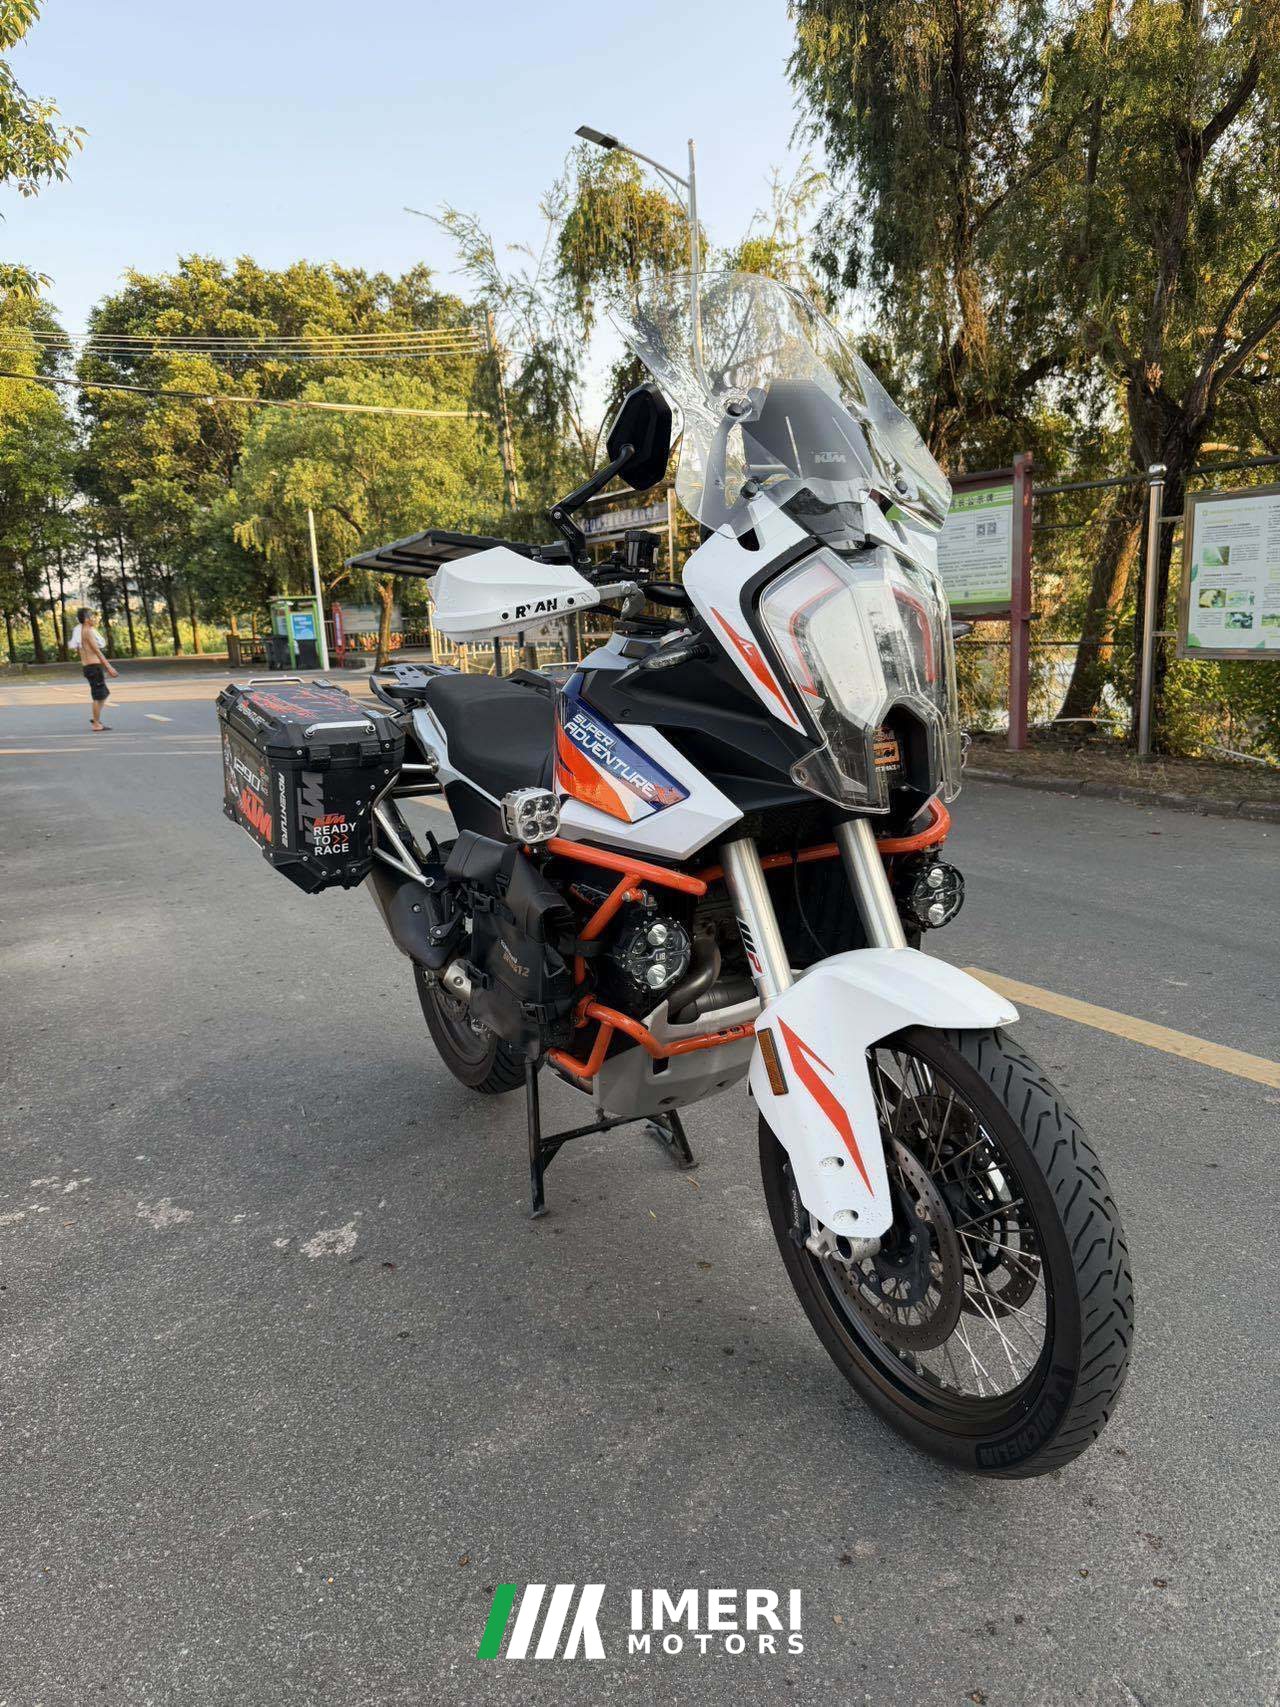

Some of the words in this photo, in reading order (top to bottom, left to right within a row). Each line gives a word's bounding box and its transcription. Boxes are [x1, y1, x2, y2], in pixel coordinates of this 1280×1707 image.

[814, 451, 847, 464] KTM
[516, 598, 558, 619] RAN
[572, 713, 615, 747] SUPER
[563, 721, 656, 798] ADVENTURE
[238, 785, 272, 843] KTM
[278, 771, 289, 848] ADVENTURE
[313, 822, 357, 836] READY
[313, 835, 331, 846] TO
[314, 843, 350, 856] RACE
